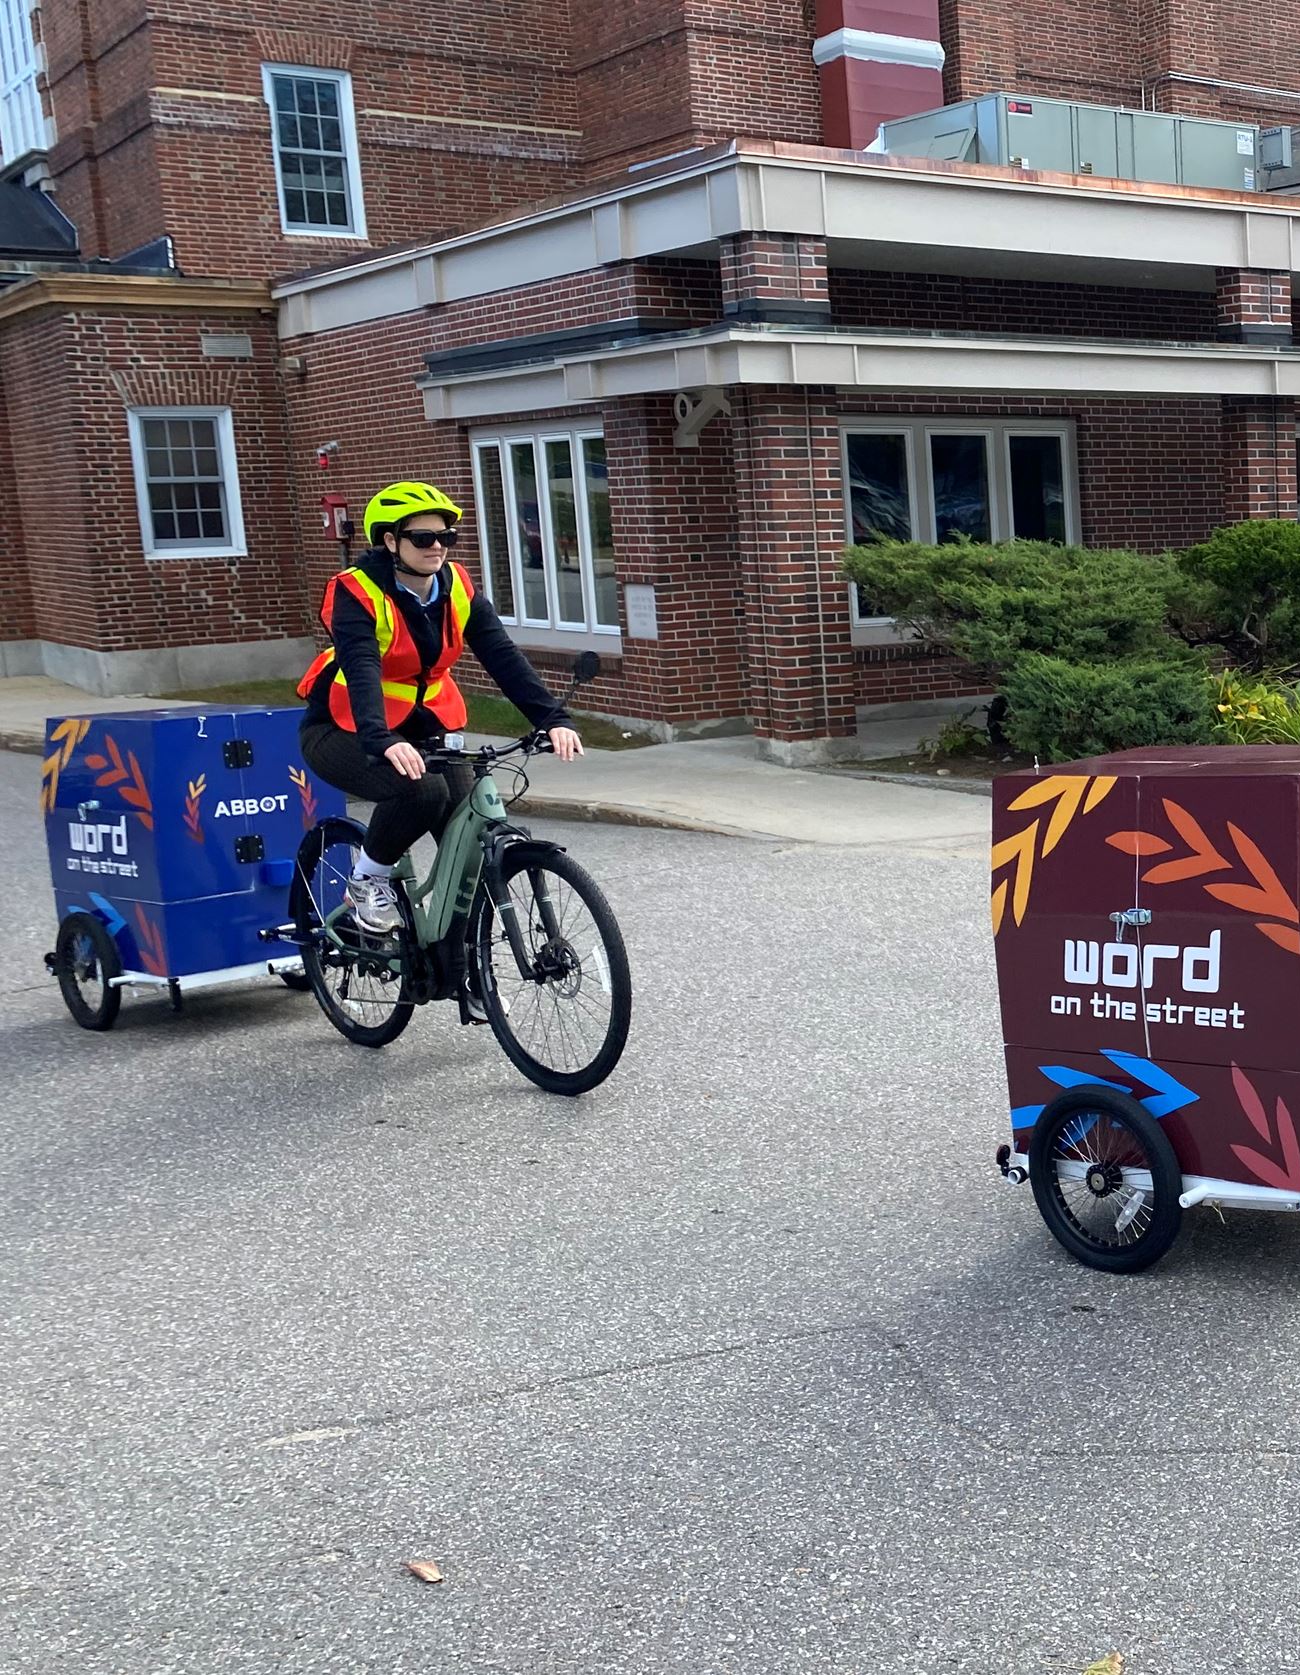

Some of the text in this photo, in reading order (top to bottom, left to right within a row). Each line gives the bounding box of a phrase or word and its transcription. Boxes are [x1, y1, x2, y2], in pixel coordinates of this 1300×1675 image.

[214, 795, 288, 818] ABBOT
[68, 814, 128, 856] word
[66, 855, 139, 878] on the street
[1064, 929, 1222, 994] word
[1050, 991, 1245, 1029] on the street
